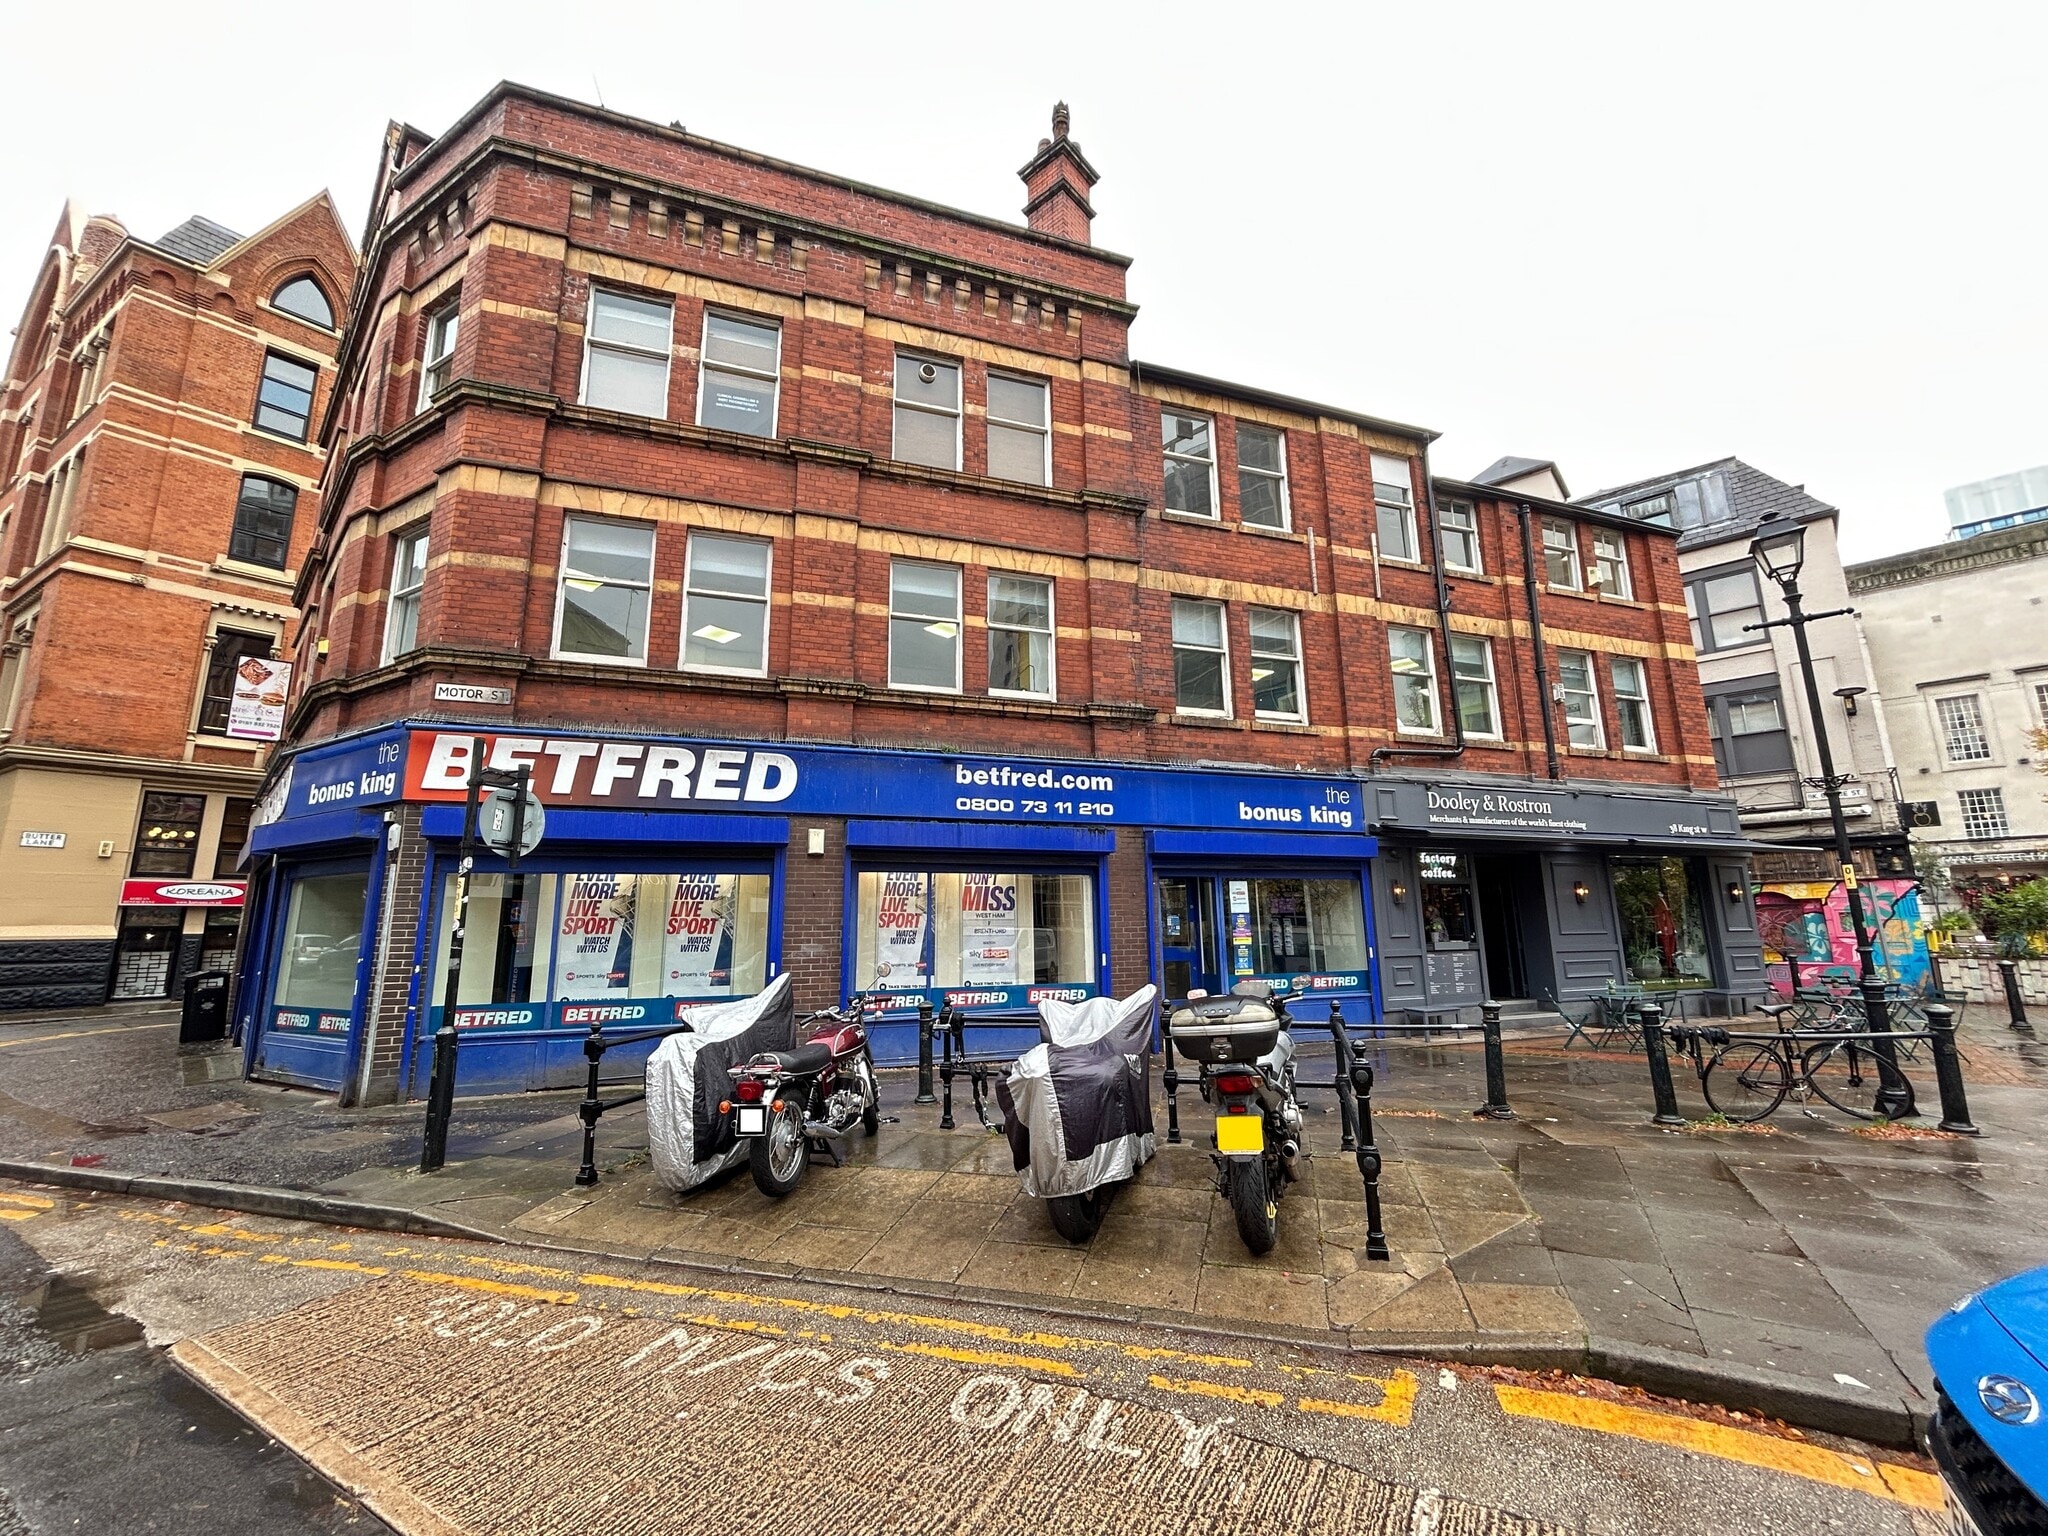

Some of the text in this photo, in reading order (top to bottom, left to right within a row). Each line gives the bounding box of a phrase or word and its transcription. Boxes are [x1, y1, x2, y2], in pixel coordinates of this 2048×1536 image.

[438, 686, 483, 699] MOTOR
[378, 741, 400, 765] the
[420, 734, 798, 802] BETFRED
[956, 764, 1113, 791] betfred.com
[308, 771, 396, 805] bonus king
[1325, 786, 1350, 804] the
[956, 797, 1114, 816] 0800 73 11 210
[1427, 791, 1552, 816] Dooley & Rostron
[1239, 801, 1352, 828] bonus king
[1429, 814, 1461, 824] Merchants
[1462, 816, 1468, 824] &
[1511, 818, 1518, 826] of
[1518, 818, 1527, 826] the
[1419, 852, 1457, 867] factory
[1421, 867, 1456, 878] coffee.
[165, 888, 234, 896] KOREANA
[571, 883, 620, 899] MORE
[674, 884, 721, 901] MORE
[883, 882, 923, 897] MORE
[880, 897, 909, 913] LIVE
[962, 885, 1015, 911] MISS
[566, 900, 602, 917] LIVE
[670, 900, 704, 918] LIVE
[562, 917, 618, 935] SPORT
[666, 917, 720, 935] SPORT
[878, 912, 922, 929] SPORT
[584, 936, 610, 945] WATCH
[687, 936, 712, 945] WATCH
[890, 937, 916, 945] WITH US
[896, 930, 917, 938] WATCH
[576, 945, 609, 953] WITH US
[680, 945, 711, 953] WITH US
[969, 950, 982, 958] sky
[1313, 976, 1358, 987] BETFRED
[948, 992, 1008, 1005] BETFRED
[1030, 989, 1087, 1001] BETFRED
[277, 1012, 310, 1028] BETFRED
[565, 1005, 646, 1022] BETFRED
[320, 1016, 351, 1031] BETFRE
